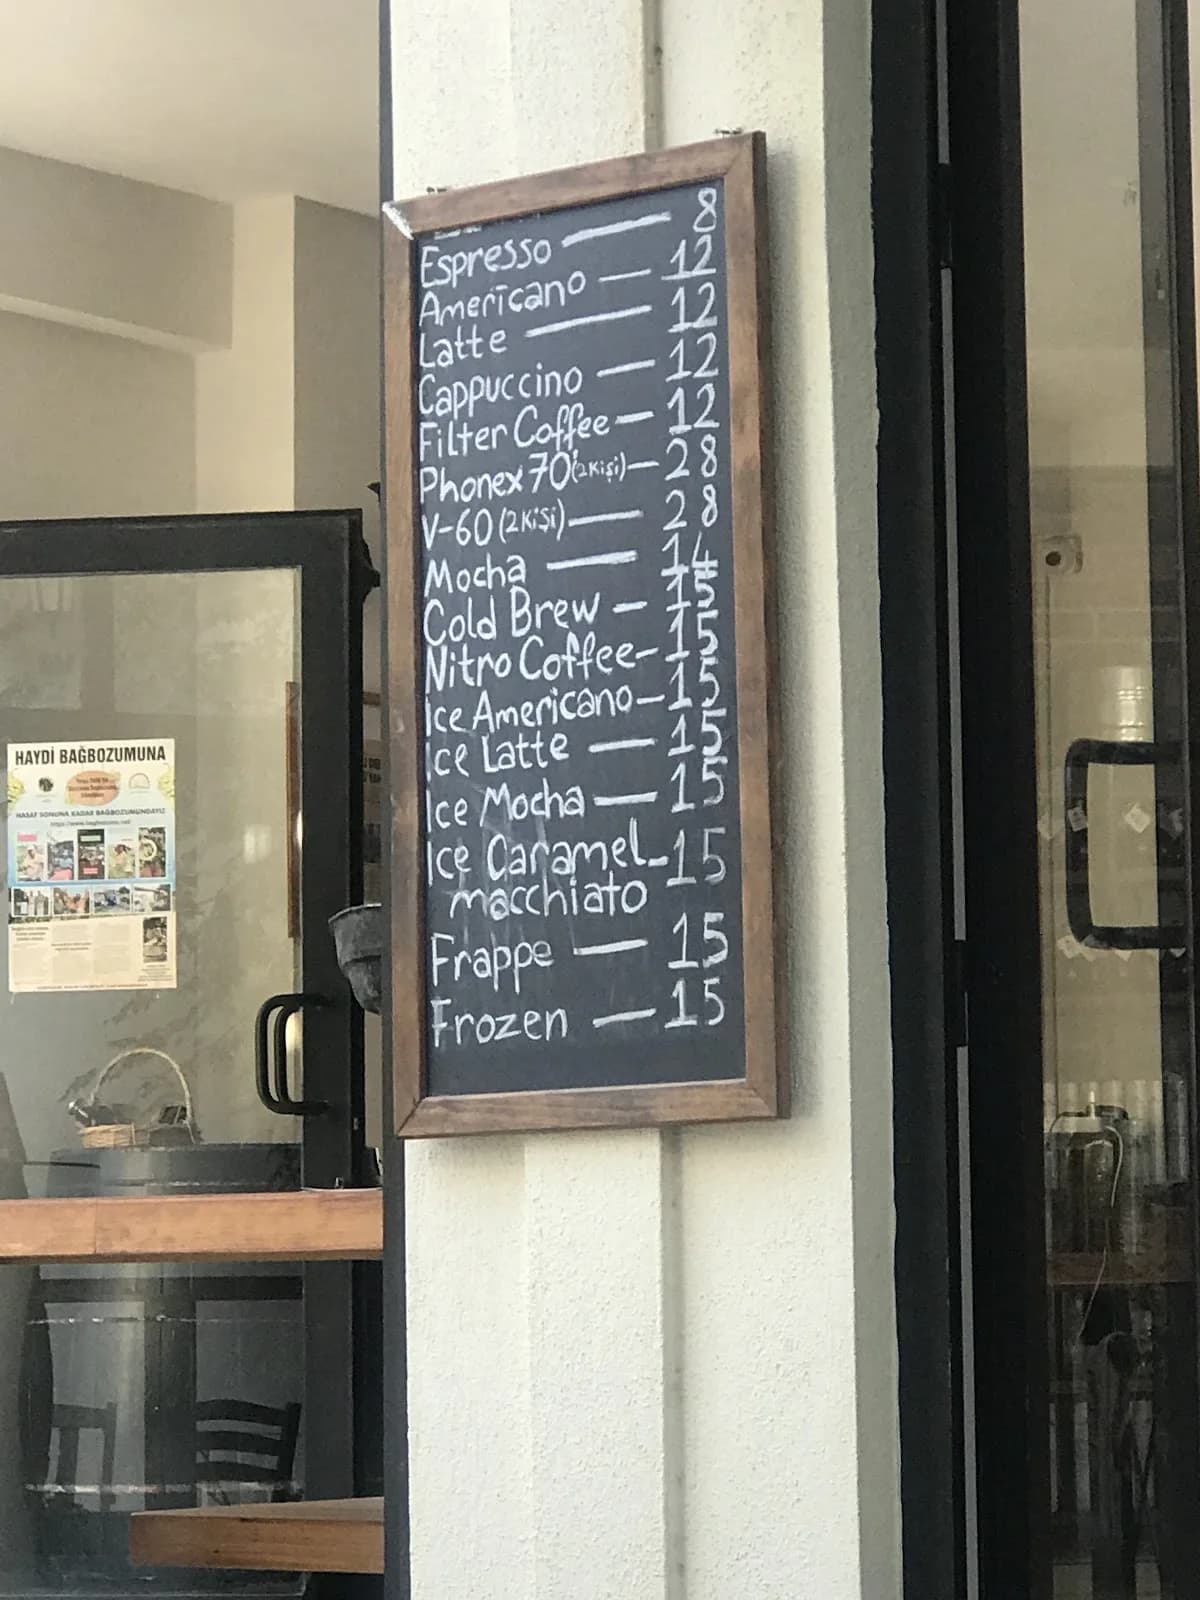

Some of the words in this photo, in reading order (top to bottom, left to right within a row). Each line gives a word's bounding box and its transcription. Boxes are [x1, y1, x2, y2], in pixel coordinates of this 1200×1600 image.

[420, 238, 552, 288] Espresso
[693, 187, 718, 233] 8
[419, 270, 586, 326] Americano
[661, 234, 717, 280] 12
[419, 324, 507, 368] Latte
[668, 282, 718, 332] 12
[418, 363, 583, 419] Cappuccino
[665, 332, 719, 382] 12
[419, 420, 508, 461] Filter
[513, 403, 610, 451] Coffee
[666, 383, 720, 434] 12
[420, 465, 523, 503] Phonex
[665, 434, 718, 481] 28
[421, 508, 493, 550] V-60
[663, 484, 718, 531] 28
[424, 552, 526, 597] Mocha
[661, 531, 719, 576] 14
[423, 595, 496, 646] Cold
[510, 585, 600, 637] Brew
[666, 569, 719, 611] 15
[425, 643, 512, 694] Nitro
[519, 631, 636, 681] Coffee
[665, 609, 719, 662] 15
[425, 696, 468, 736] Ice
[472, 685, 633, 733] Americano
[668, 656, 719, 711] 15
[15, 749, 55, 765] HAYDİ
[59, 745, 166, 764] BAĞBOZUMUNA
[425, 741, 469, 780] Ice
[483, 731, 569, 773] Latte
[667, 709, 727, 757] 15
[425, 788, 468, 833] Ice
[479, 777, 585, 827] Mocha
[670, 757, 728, 813] 15
[426, 841, 471, 887] Ice
[486, 817, 648, 881] Caramel
[666, 827, 727, 887] 15
[449, 870, 648, 921] macchiato
[431, 932, 554, 994] Frappe
[667, 912, 729, 969] 15
[430, 996, 568, 1047] Frozen
[664, 977, 726, 1029] 15
